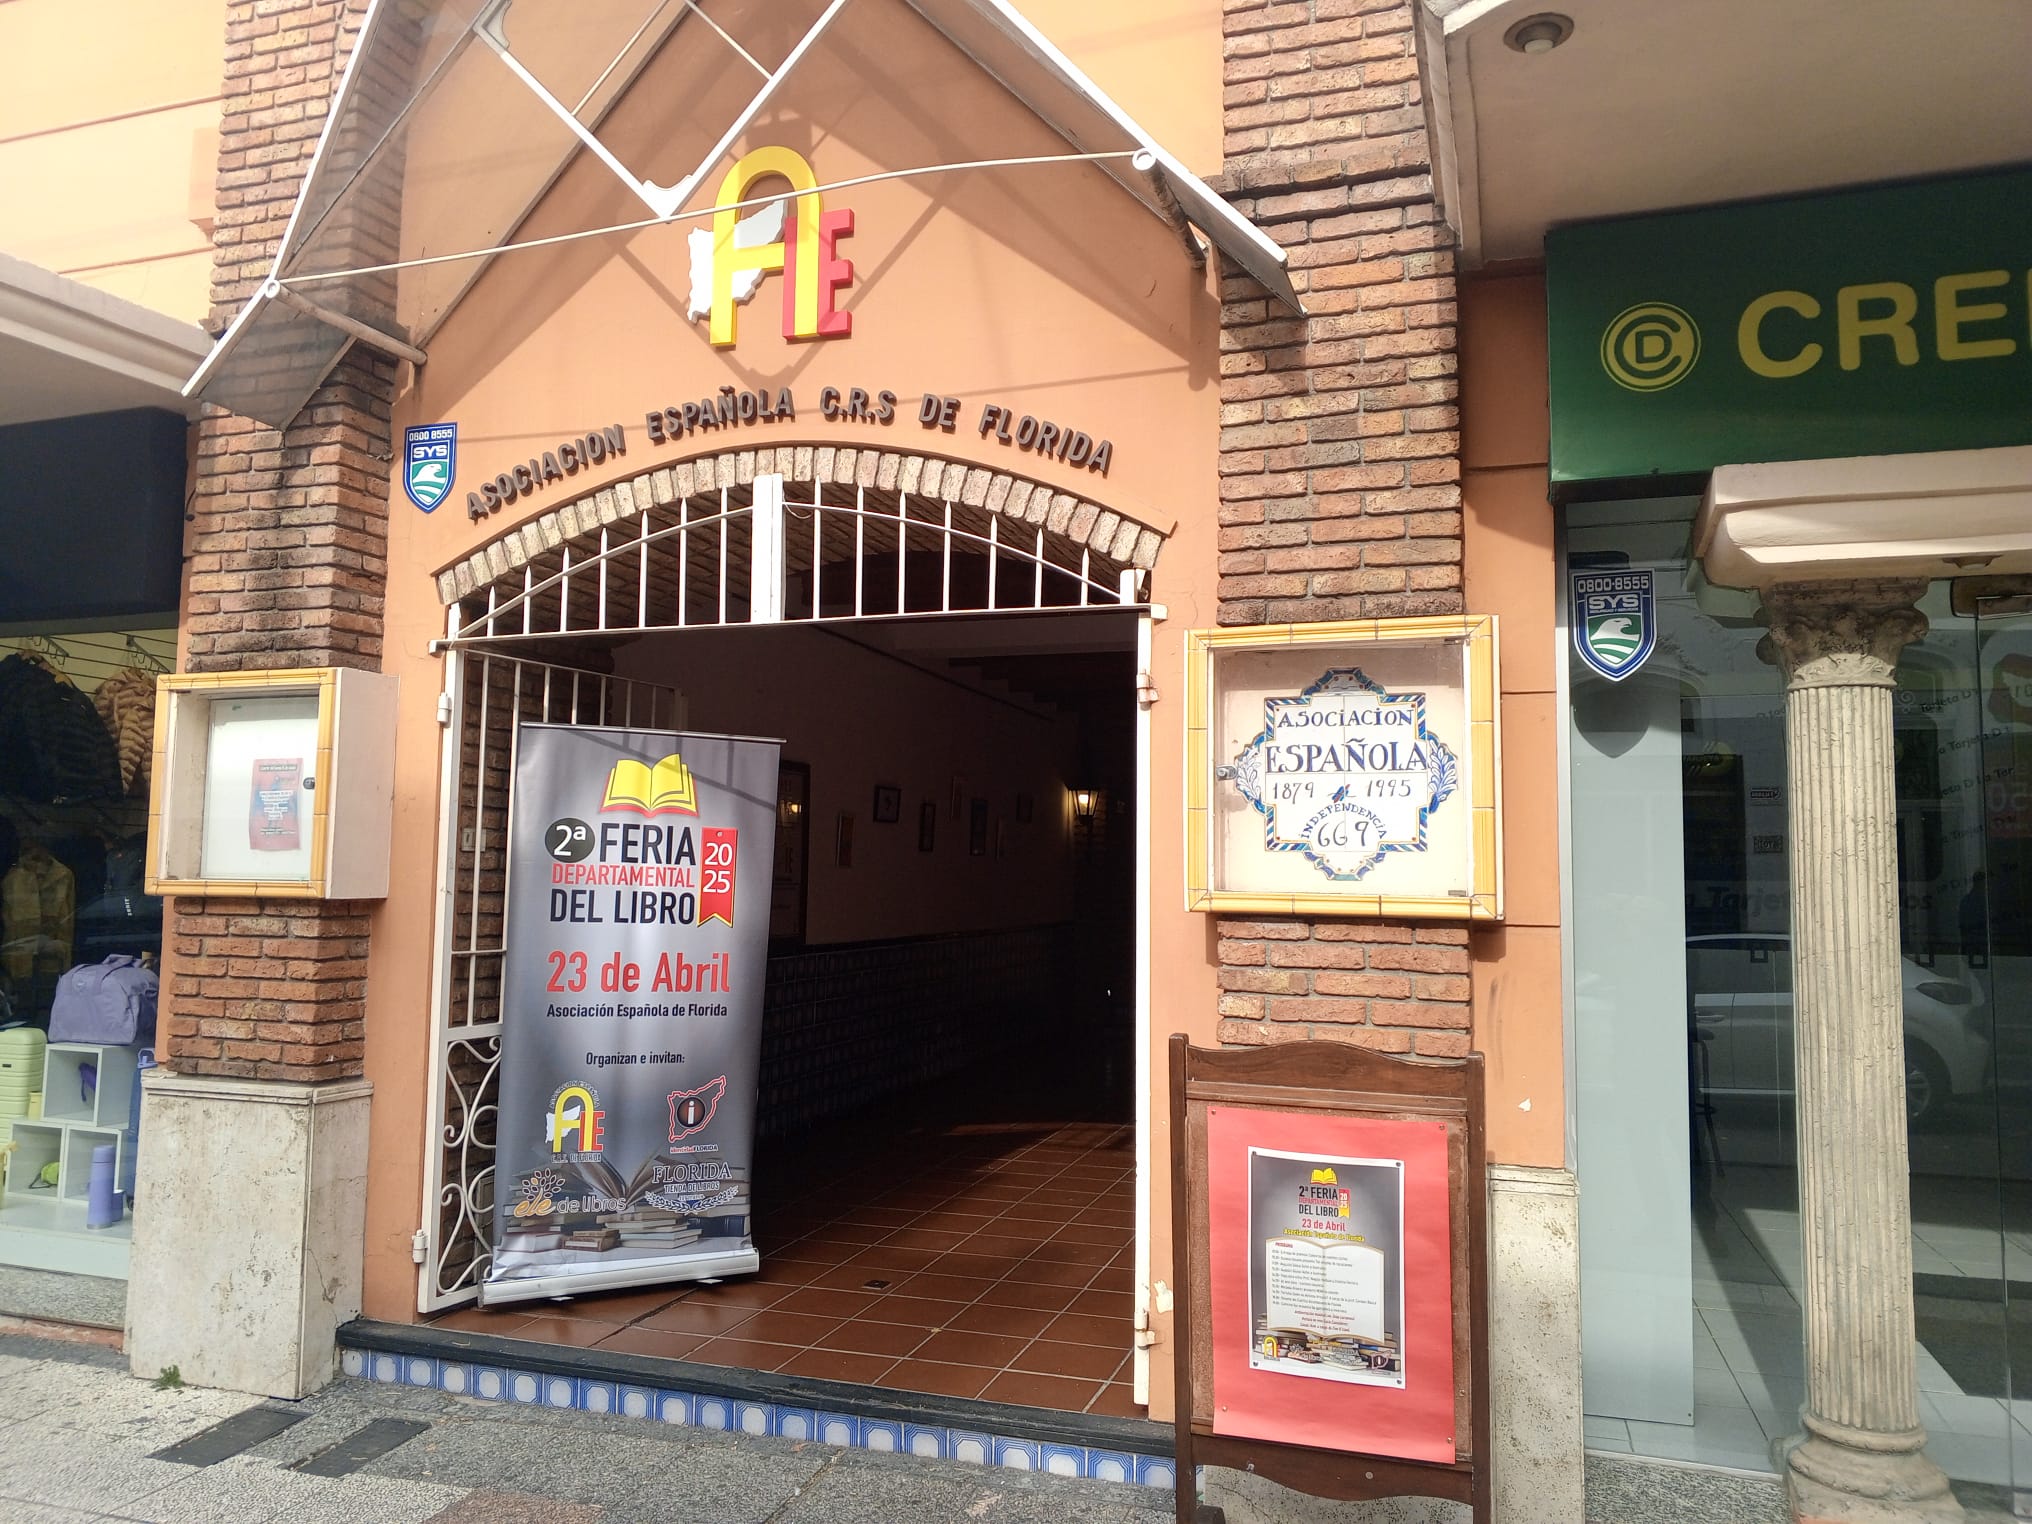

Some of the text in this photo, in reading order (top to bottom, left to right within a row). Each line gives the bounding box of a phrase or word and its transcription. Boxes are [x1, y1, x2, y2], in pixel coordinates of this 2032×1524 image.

[1738, 270, 2032, 378] CRE
[409, 429, 453, 441] 0800 8555
[413, 445, 447, 458] SYS
[467, 424, 627, 524] ASOCIACION
[646, 385, 796, 445] ESPAÑOLA
[920, 393, 961, 433] DE
[979, 404, 1114, 478] FLORIDA
[1589, 594, 1639, 610] SYS
[1266, 738, 1428, 773] ESPAÑOLA
[1273, 780, 1411, 804] 1879 1995
[1299, 803, 1387, 839] INDEPENDENCIA
[1317, 820, 1369, 847] 669
[599, 823, 697, 866] FERIA
[551, 864, 695, 888] DEPARTAMENTAL
[550, 889, 695, 925] DEL LIBRO
[546, 951, 730, 993] 23 de Abril
[547, 1003, 727, 1021] Asociación Española de Florida
[586, 1050, 685, 1068] Organizan e invitan:
[652, 1162, 732, 1183] FLORIDA
[664, 1181, 720, 1193] TIENDA DE LIBROS
[1310, 1186, 1338, 1200] FERIA
[557, 1197, 580, 1213] de
[582, 1196, 627, 1212] libros
[1298, 1204, 1339, 1217] DEL LIBRO
[1302, 1218, 1346, 1232] 23 de Abril
